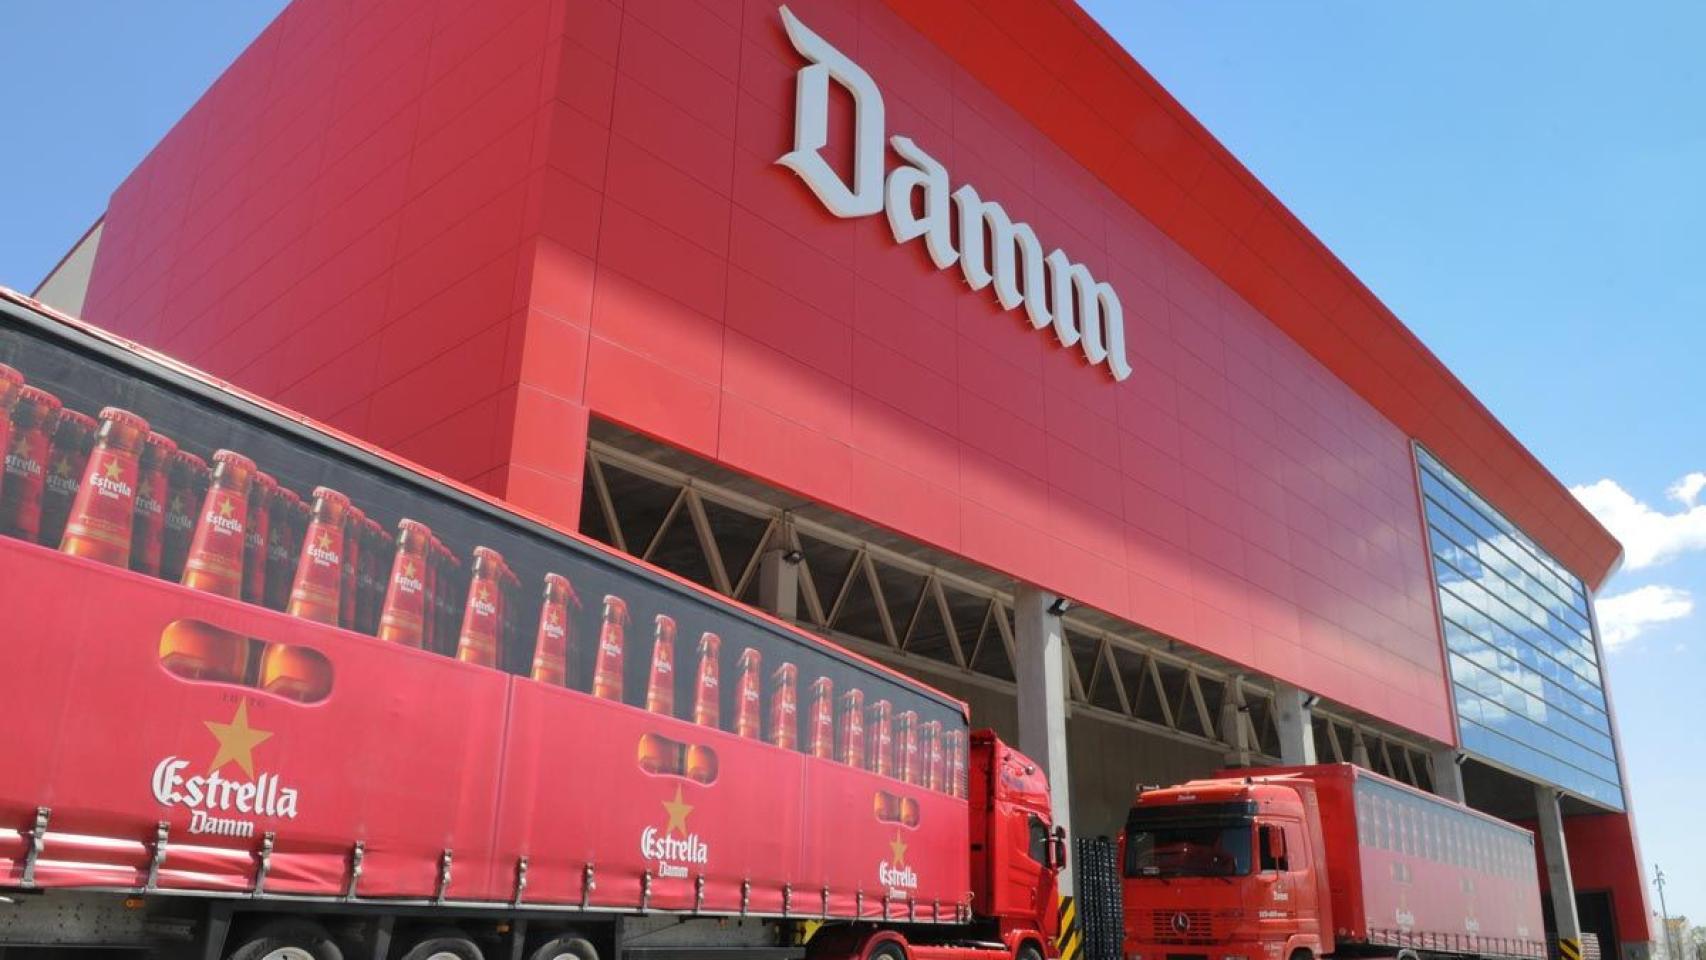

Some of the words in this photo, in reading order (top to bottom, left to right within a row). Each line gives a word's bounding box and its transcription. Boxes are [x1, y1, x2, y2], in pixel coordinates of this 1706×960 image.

[774, 4, 1132, 382] Damm
[5, 454, 41, 474] strella
[90, 472, 132, 497] Estrella
[205, 511, 242, 532] Estrella
[307, 544, 339, 564] Estrella
[152, 756, 298, 818] Estrella
[188, 809, 254, 837] Damm
[641, 825, 708, 864] Estrella
[658, 861, 689, 878] Damm
[879, 860, 918, 889] Estrella
